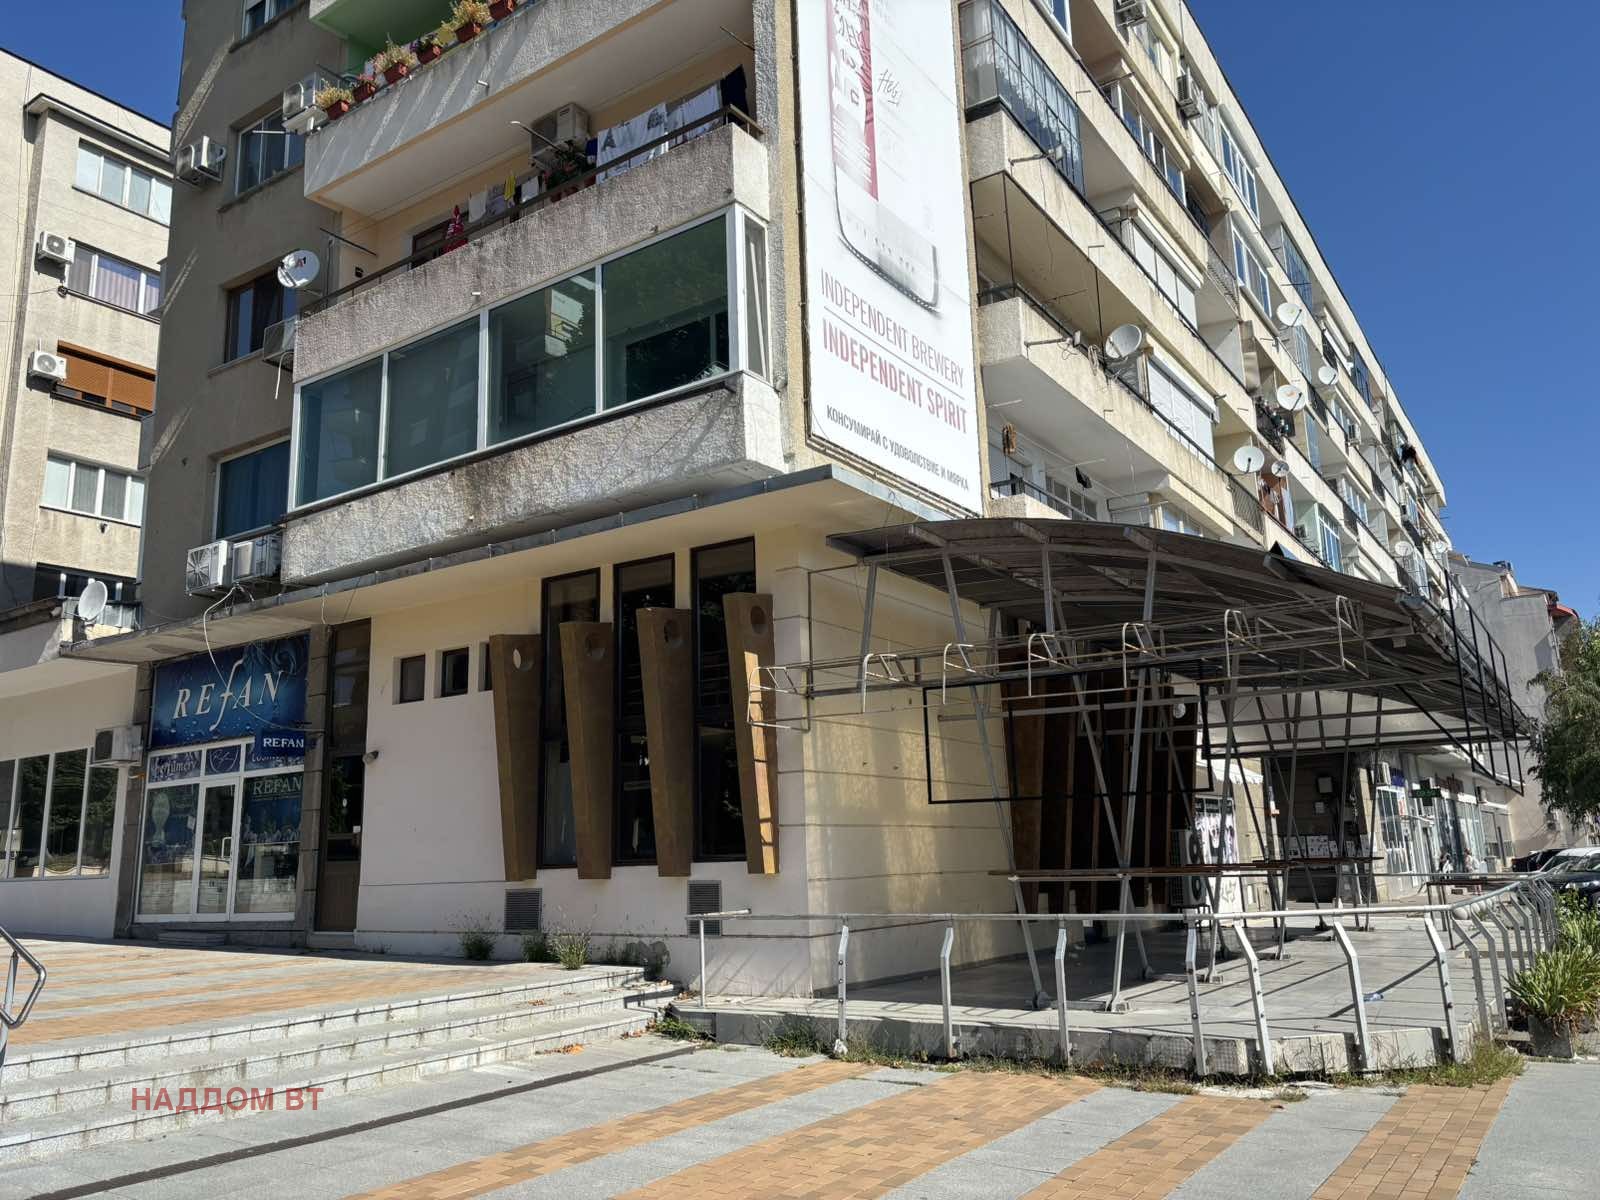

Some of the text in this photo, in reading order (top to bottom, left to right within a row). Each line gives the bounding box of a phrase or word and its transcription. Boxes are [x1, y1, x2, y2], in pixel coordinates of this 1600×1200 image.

[821, 268, 965, 388] INDEPENDENT BREWERY
[822, 318, 967, 434] INDEPENDENT SPIRIT
[826, 405, 881, 448] КОНСУМИРАЙ
[882, 434, 889, 450] С
[890, 440, 940, 477] УДОВОЛСТВИЕ
[941, 466, 947, 481] И
[263, 737, 304, 748] REFAN
[253, 776, 302, 795] REFAN
